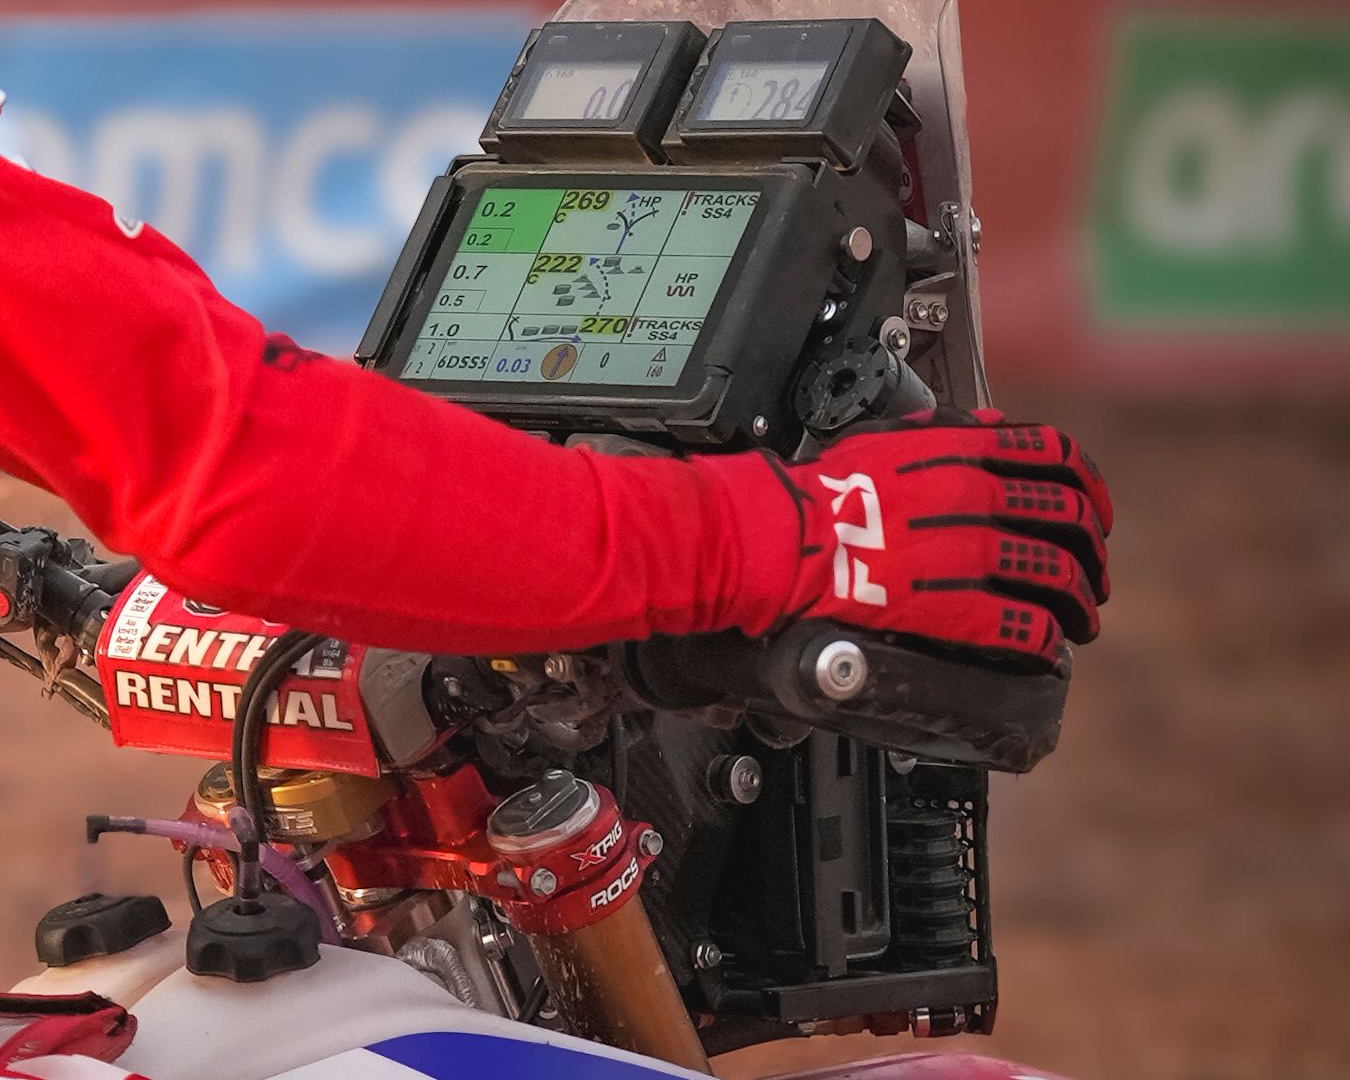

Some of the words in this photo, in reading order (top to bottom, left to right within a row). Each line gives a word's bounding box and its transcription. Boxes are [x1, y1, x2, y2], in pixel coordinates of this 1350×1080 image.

[561, 191, 610, 210] 269
[638, 196, 662, 208] HP
[692, 194, 759, 206] TRACKS
[481, 201, 516, 218] 0.2
[701, 207, 733, 219] SS4
[466, 233, 493, 246] 0.2
[532, 255, 583, 273] 222
[453, 264, 488, 280] 0.7
[674, 273, 699, 284] HP
[439, 295, 465, 307] 0.5
[429, 323, 460, 337] 1.0
[579, 318, 628, 334] 270
[638, 320, 704, 331] TRACKS
[647, 331, 679, 341] SS4
[496, 358, 532, 373] 0.03
[599, 352, 610, 368] 0
[818, 472, 888, 607] FLY
[570, 820, 623, 871] XTRIG
[590, 857, 639, 909] ROCS
